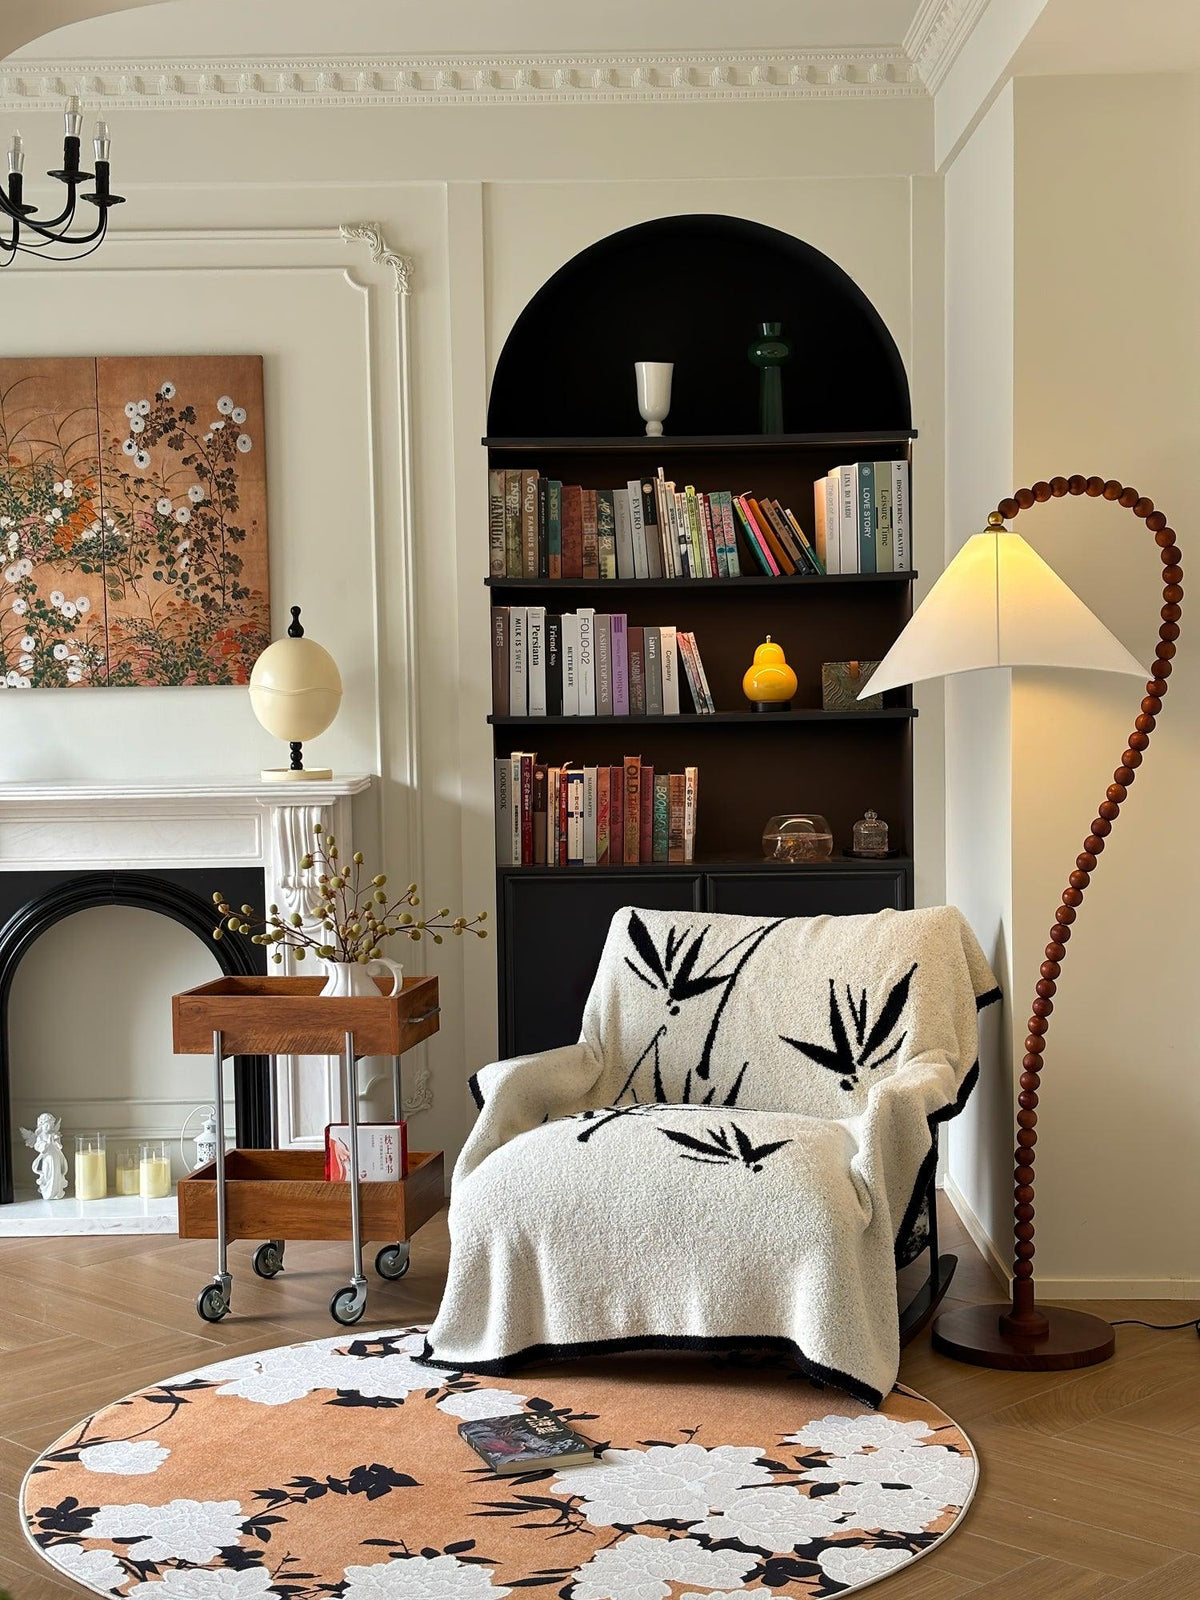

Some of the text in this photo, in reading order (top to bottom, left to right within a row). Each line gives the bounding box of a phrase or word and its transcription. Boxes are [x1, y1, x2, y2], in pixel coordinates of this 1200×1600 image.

[510, 482, 519, 517] INDIE
[525, 476, 536, 513] WORLD
[550, 488, 558, 520] INDIE
[491, 495, 504, 552] BANQUET
[632, 498, 641, 531] EVERO
[881, 489, 890, 546] Leisure Time
[532, 625, 541, 666] Persiana
[549, 625, 557, 652] Friend
[580, 617, 590, 665] FOLIO-02
[600, 664, 608, 680] TOP
